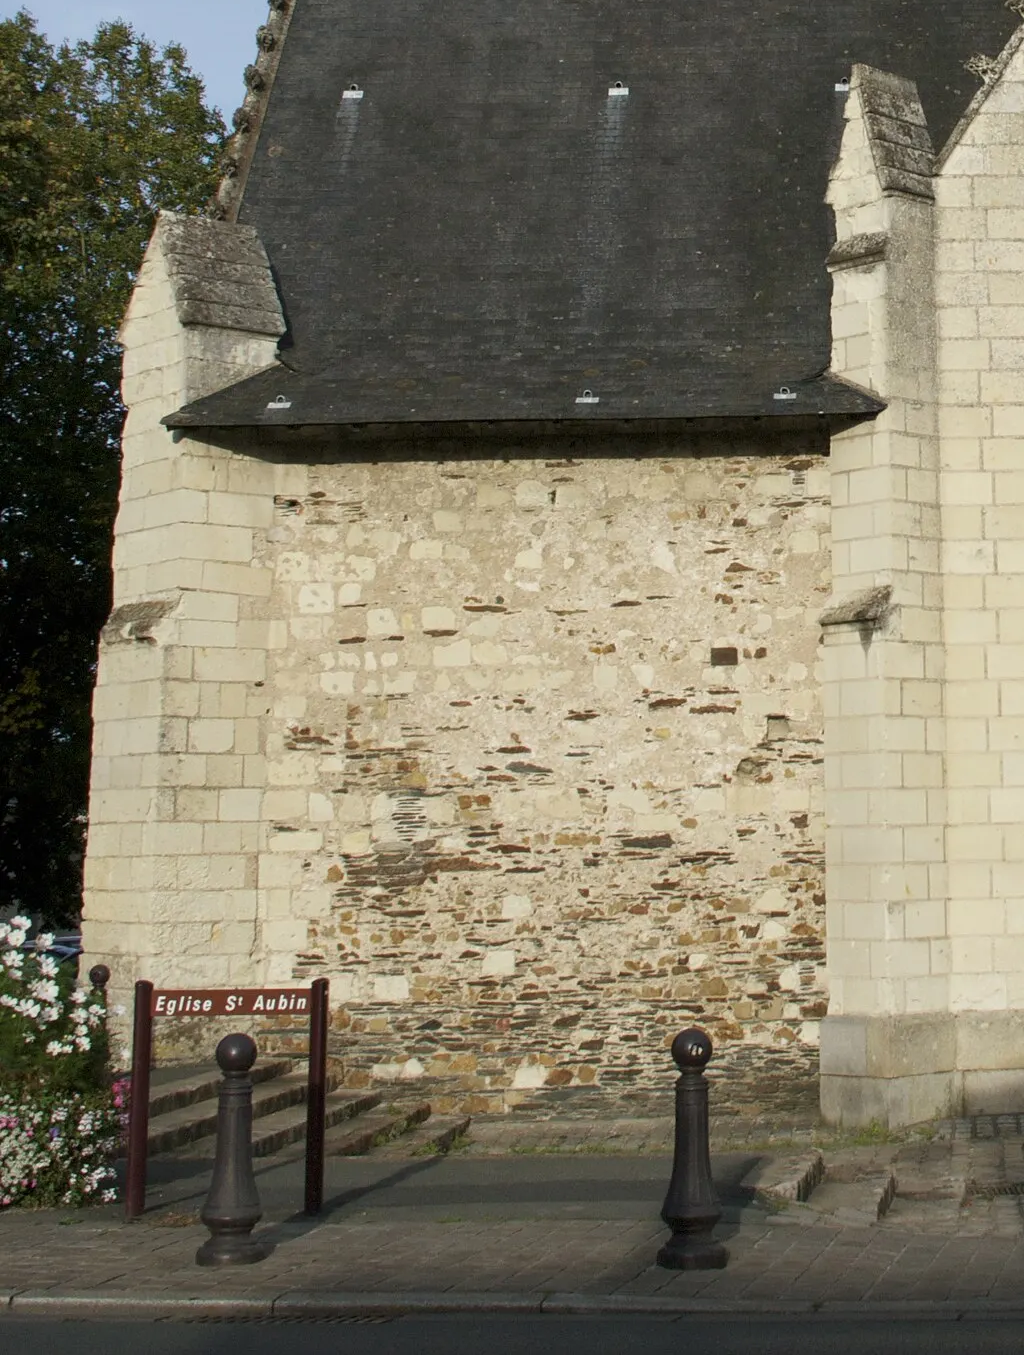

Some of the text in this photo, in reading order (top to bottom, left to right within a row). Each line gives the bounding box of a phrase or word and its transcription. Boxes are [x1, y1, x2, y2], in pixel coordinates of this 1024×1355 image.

[155, 994, 307, 1016] Eglise St Aubin
